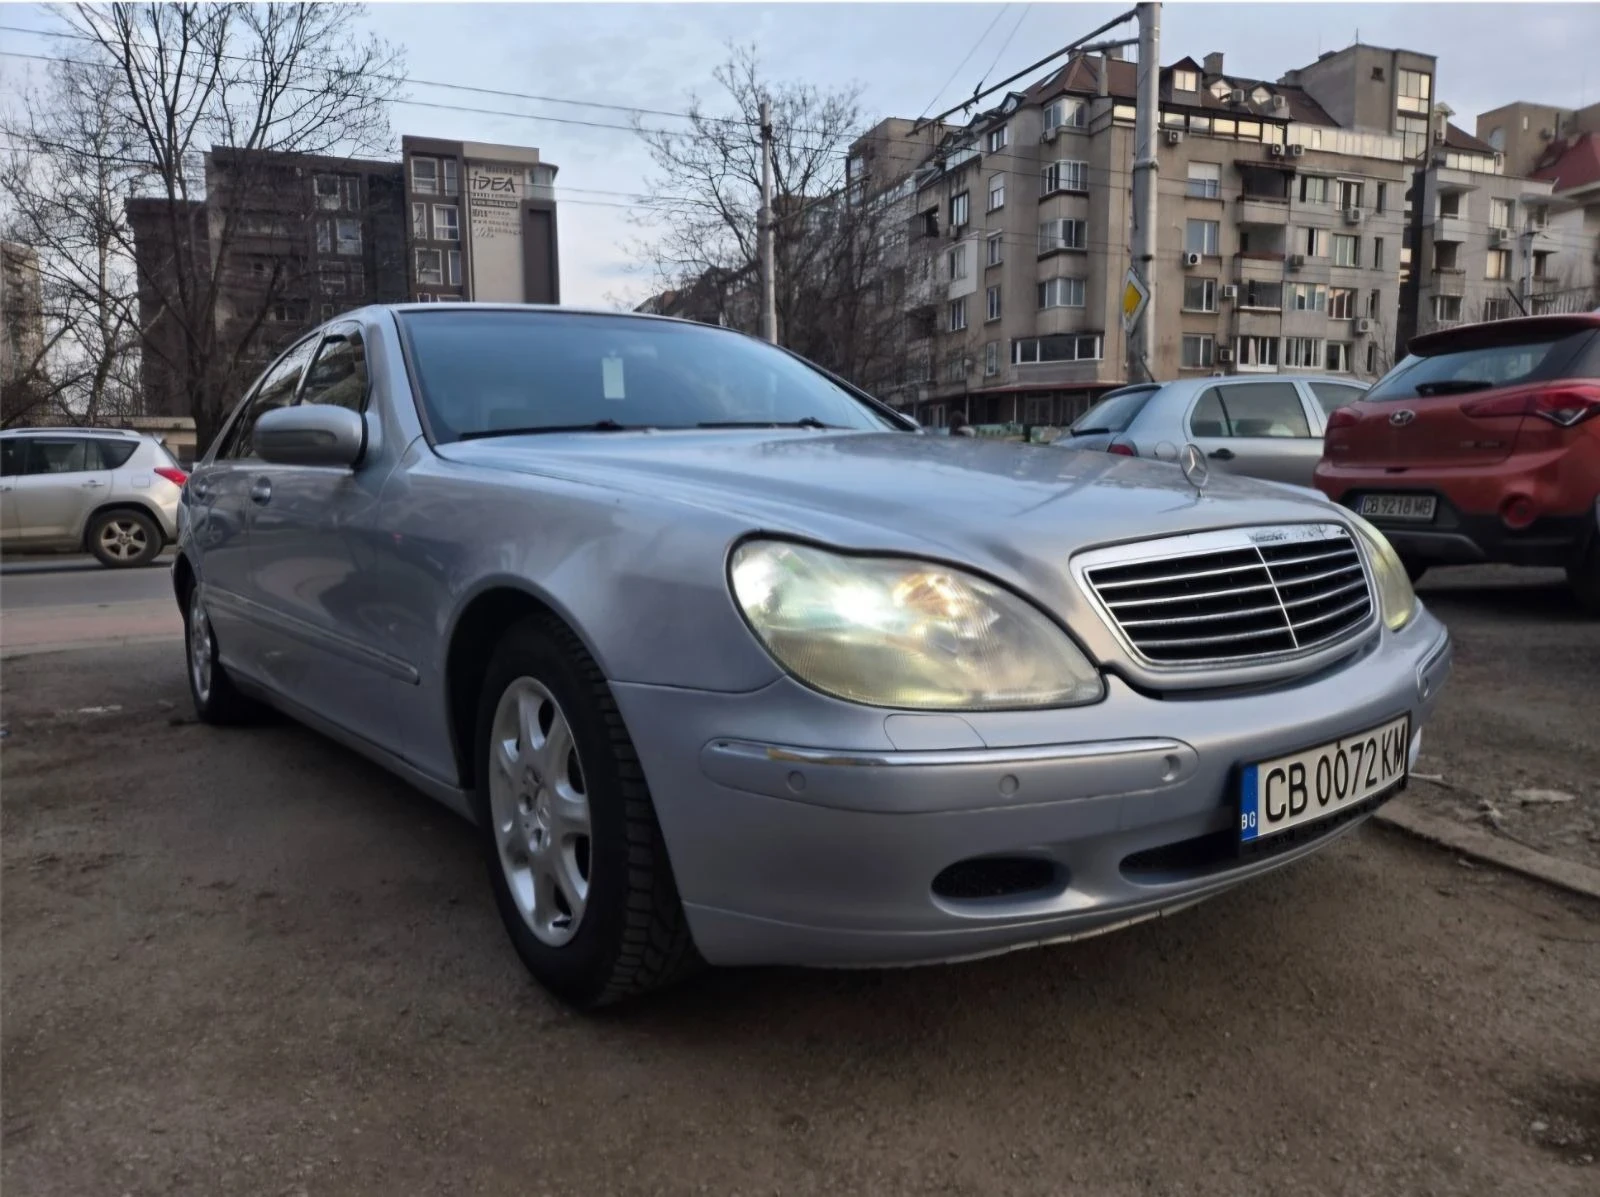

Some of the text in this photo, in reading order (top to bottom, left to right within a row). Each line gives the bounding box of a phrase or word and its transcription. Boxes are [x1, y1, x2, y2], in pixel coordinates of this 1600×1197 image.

[1363, 496, 1378, 514] CB
[1265, 723, 1406, 823] CB 0072 KM
[1241, 811, 1256, 830] BG
